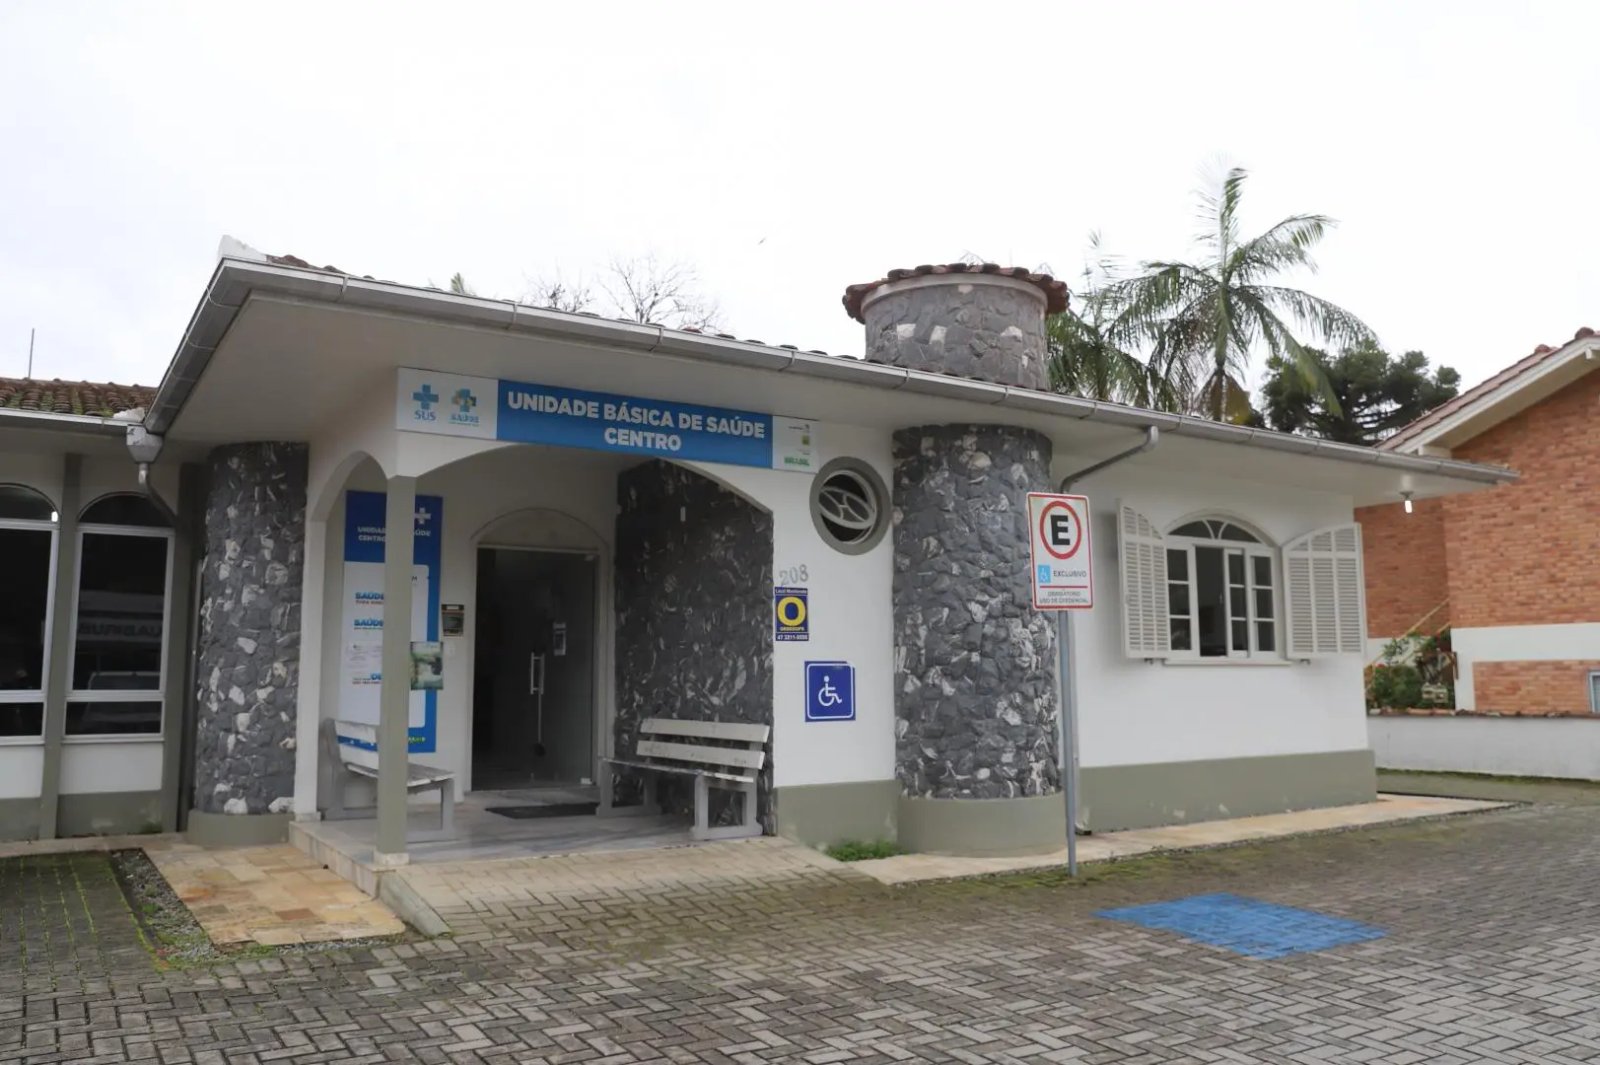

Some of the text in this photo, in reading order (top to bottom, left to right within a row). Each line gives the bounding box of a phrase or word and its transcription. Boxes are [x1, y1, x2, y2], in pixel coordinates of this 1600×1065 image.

[414, 409, 437, 421] SUS
[508, 390, 765, 439] UNIDADE BÁSICA DE SAÚDE
[604, 427, 682, 452] CENTRO
[1050, 514, 1071, 546] E
[779, 564, 809, 586] 208
[1053, 570, 1087, 578] EXCLUSIVO
